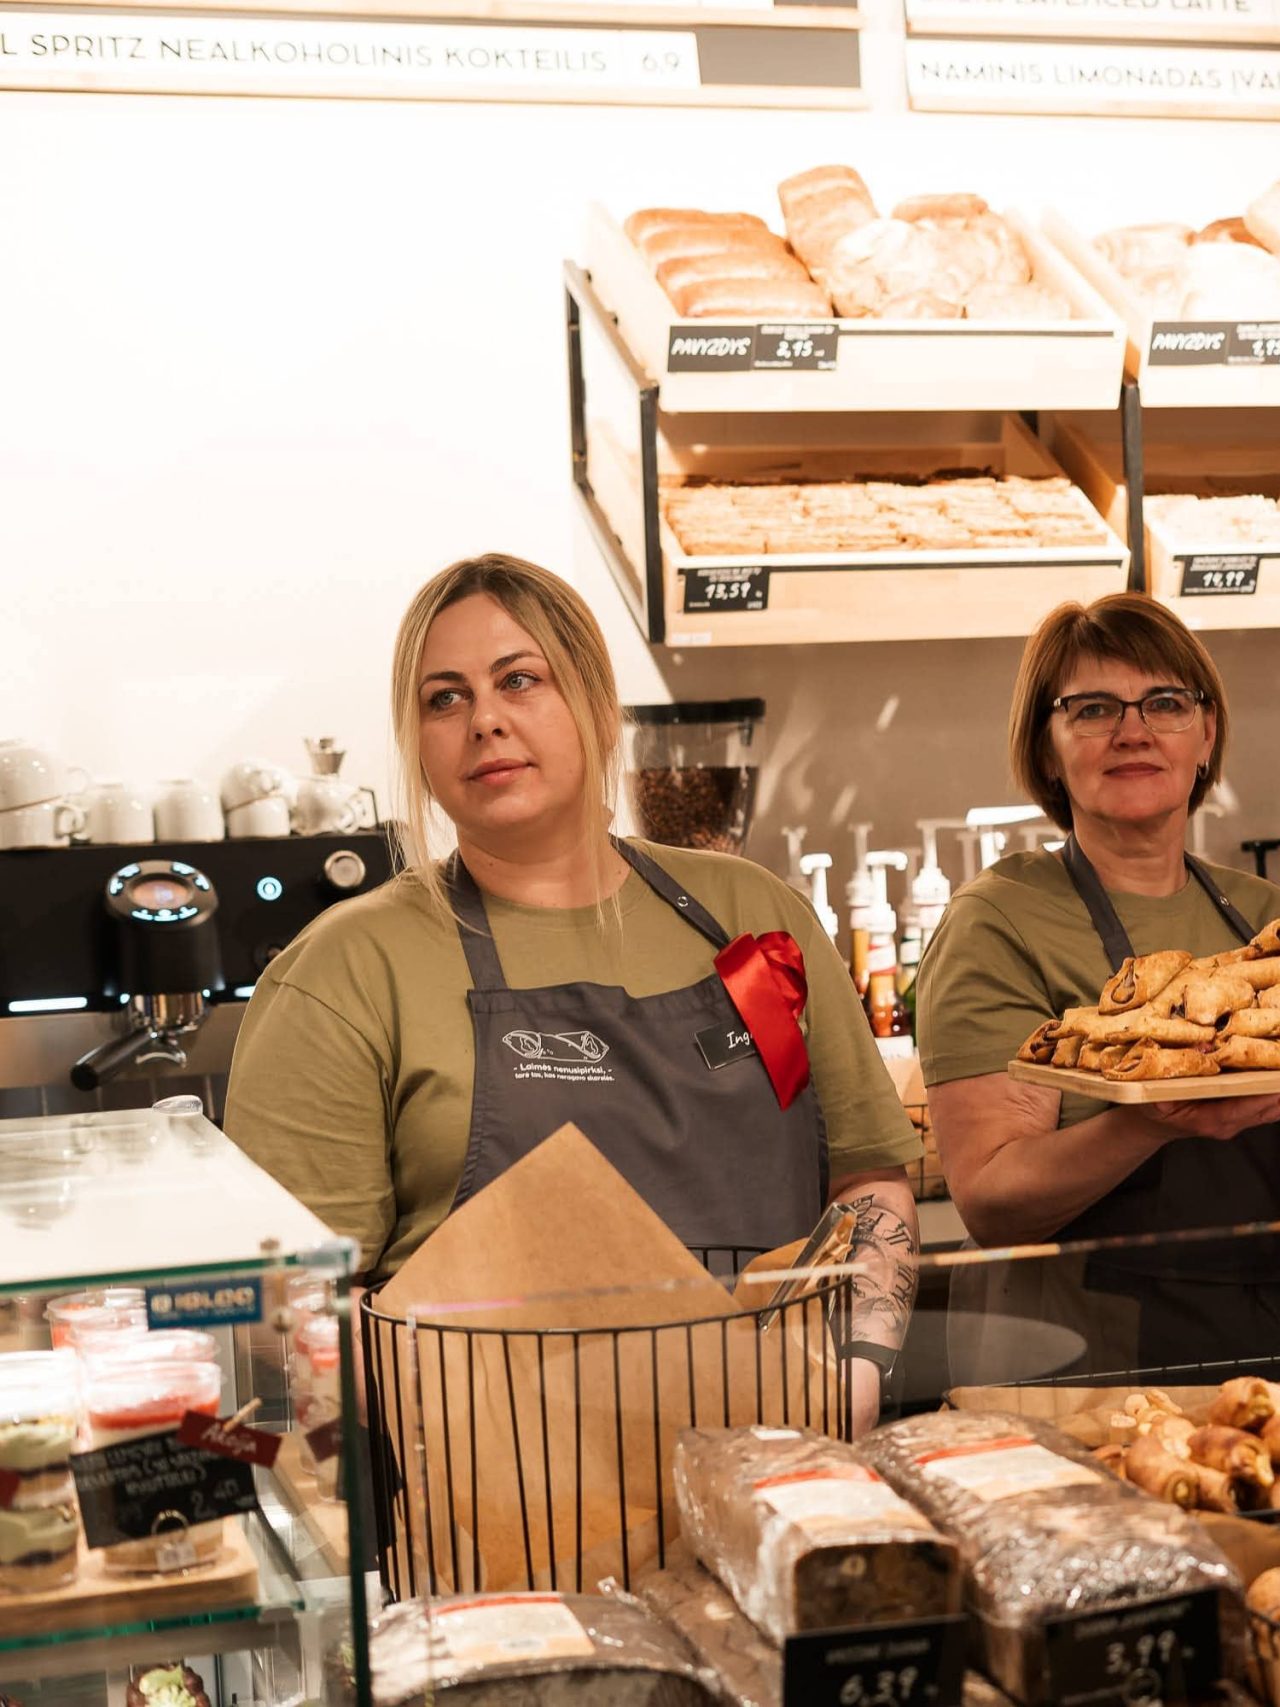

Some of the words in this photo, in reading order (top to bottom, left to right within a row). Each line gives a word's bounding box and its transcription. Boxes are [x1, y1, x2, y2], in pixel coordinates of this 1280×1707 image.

[30, 33, 147, 60] SPRITZ
[158, 38, 433, 69] NEALKOHOLINIS
[445, 47, 608, 73] KOKTEILIS
[920, 60, 1043, 86] NAMINIS
[1052, 63, 1223, 90] LIMONADAS
[671, 337, 752, 357] PAVYZDYS
[1151, 331, 1226, 351] PAVYZDYS
[705, 581, 751, 601] 13,59
[726, 1030, 753, 1049] Ing
[1105, 1629, 1177, 1675] 3,99
